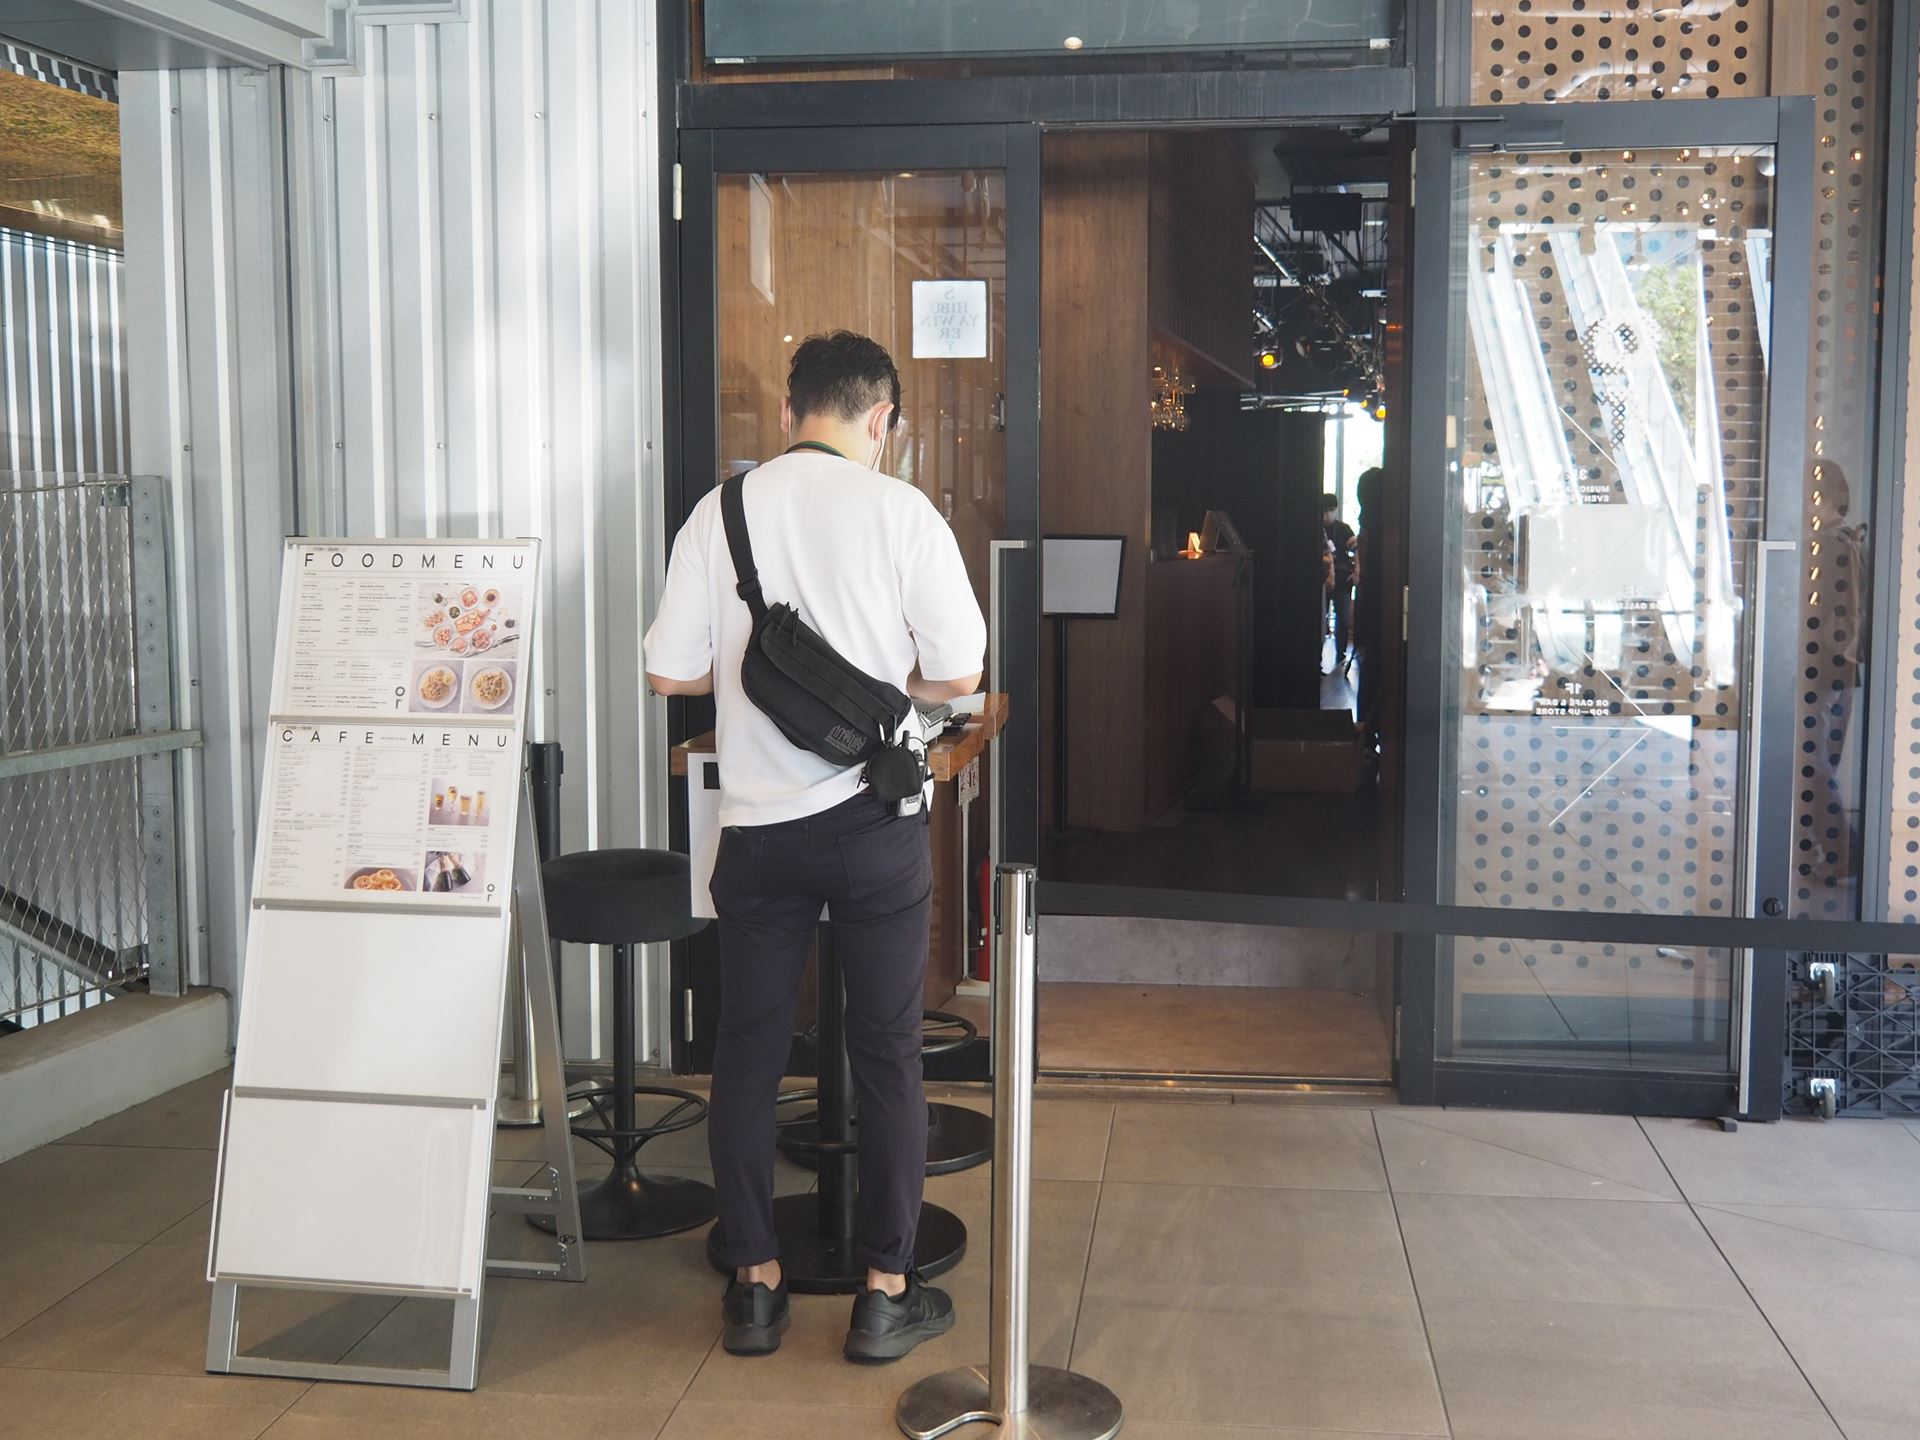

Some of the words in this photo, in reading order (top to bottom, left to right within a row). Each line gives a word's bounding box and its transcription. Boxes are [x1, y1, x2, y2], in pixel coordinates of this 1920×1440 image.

[304, 553, 403, 568] FOOD
[421, 554, 524, 569] MENU
[282, 729, 375, 744] CAFE
[411, 733, 507, 747] MENU
